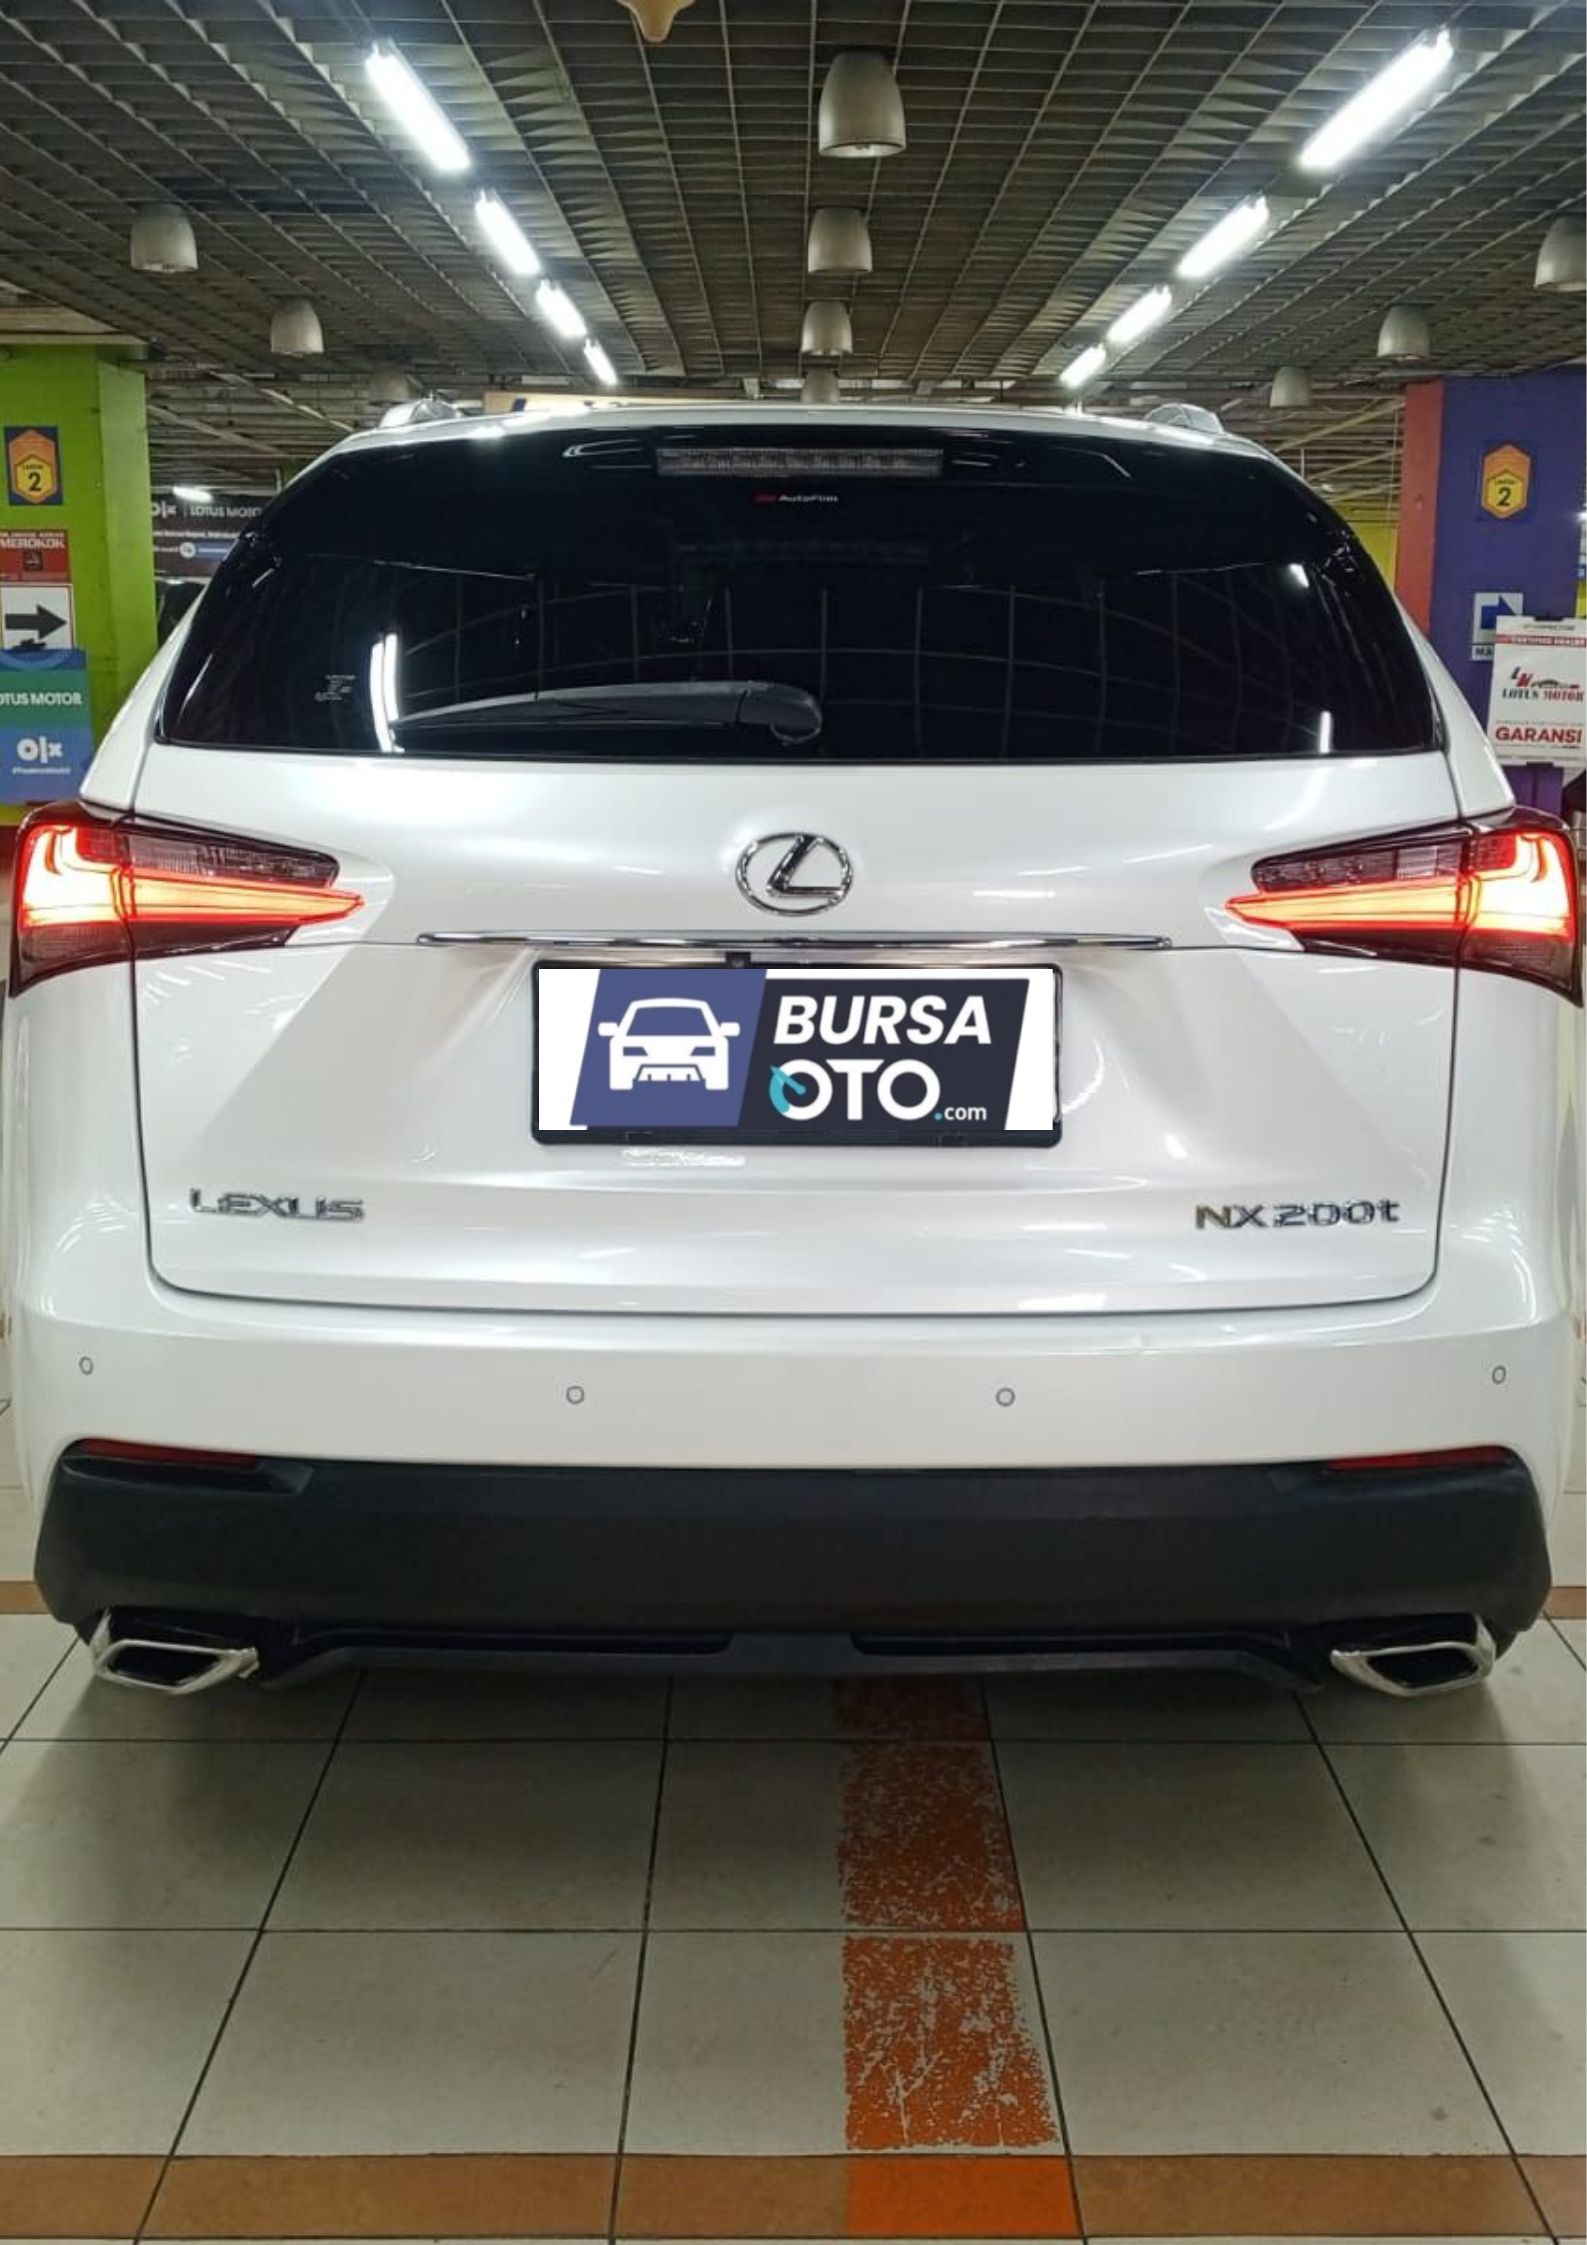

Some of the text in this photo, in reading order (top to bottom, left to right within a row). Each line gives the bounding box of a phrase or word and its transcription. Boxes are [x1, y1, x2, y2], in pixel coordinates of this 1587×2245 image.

[28, 472, 42, 491] 2
[1498, 487, 1512, 506] 2
[190, 506, 225, 517] LOTUS
[226, 507, 262, 517] MOTO
[0, 692, 82, 706] OTUS MOTOR
[1495, 726, 1583, 743] GARANSI
[190, 1188, 365, 1222] LEXUS
